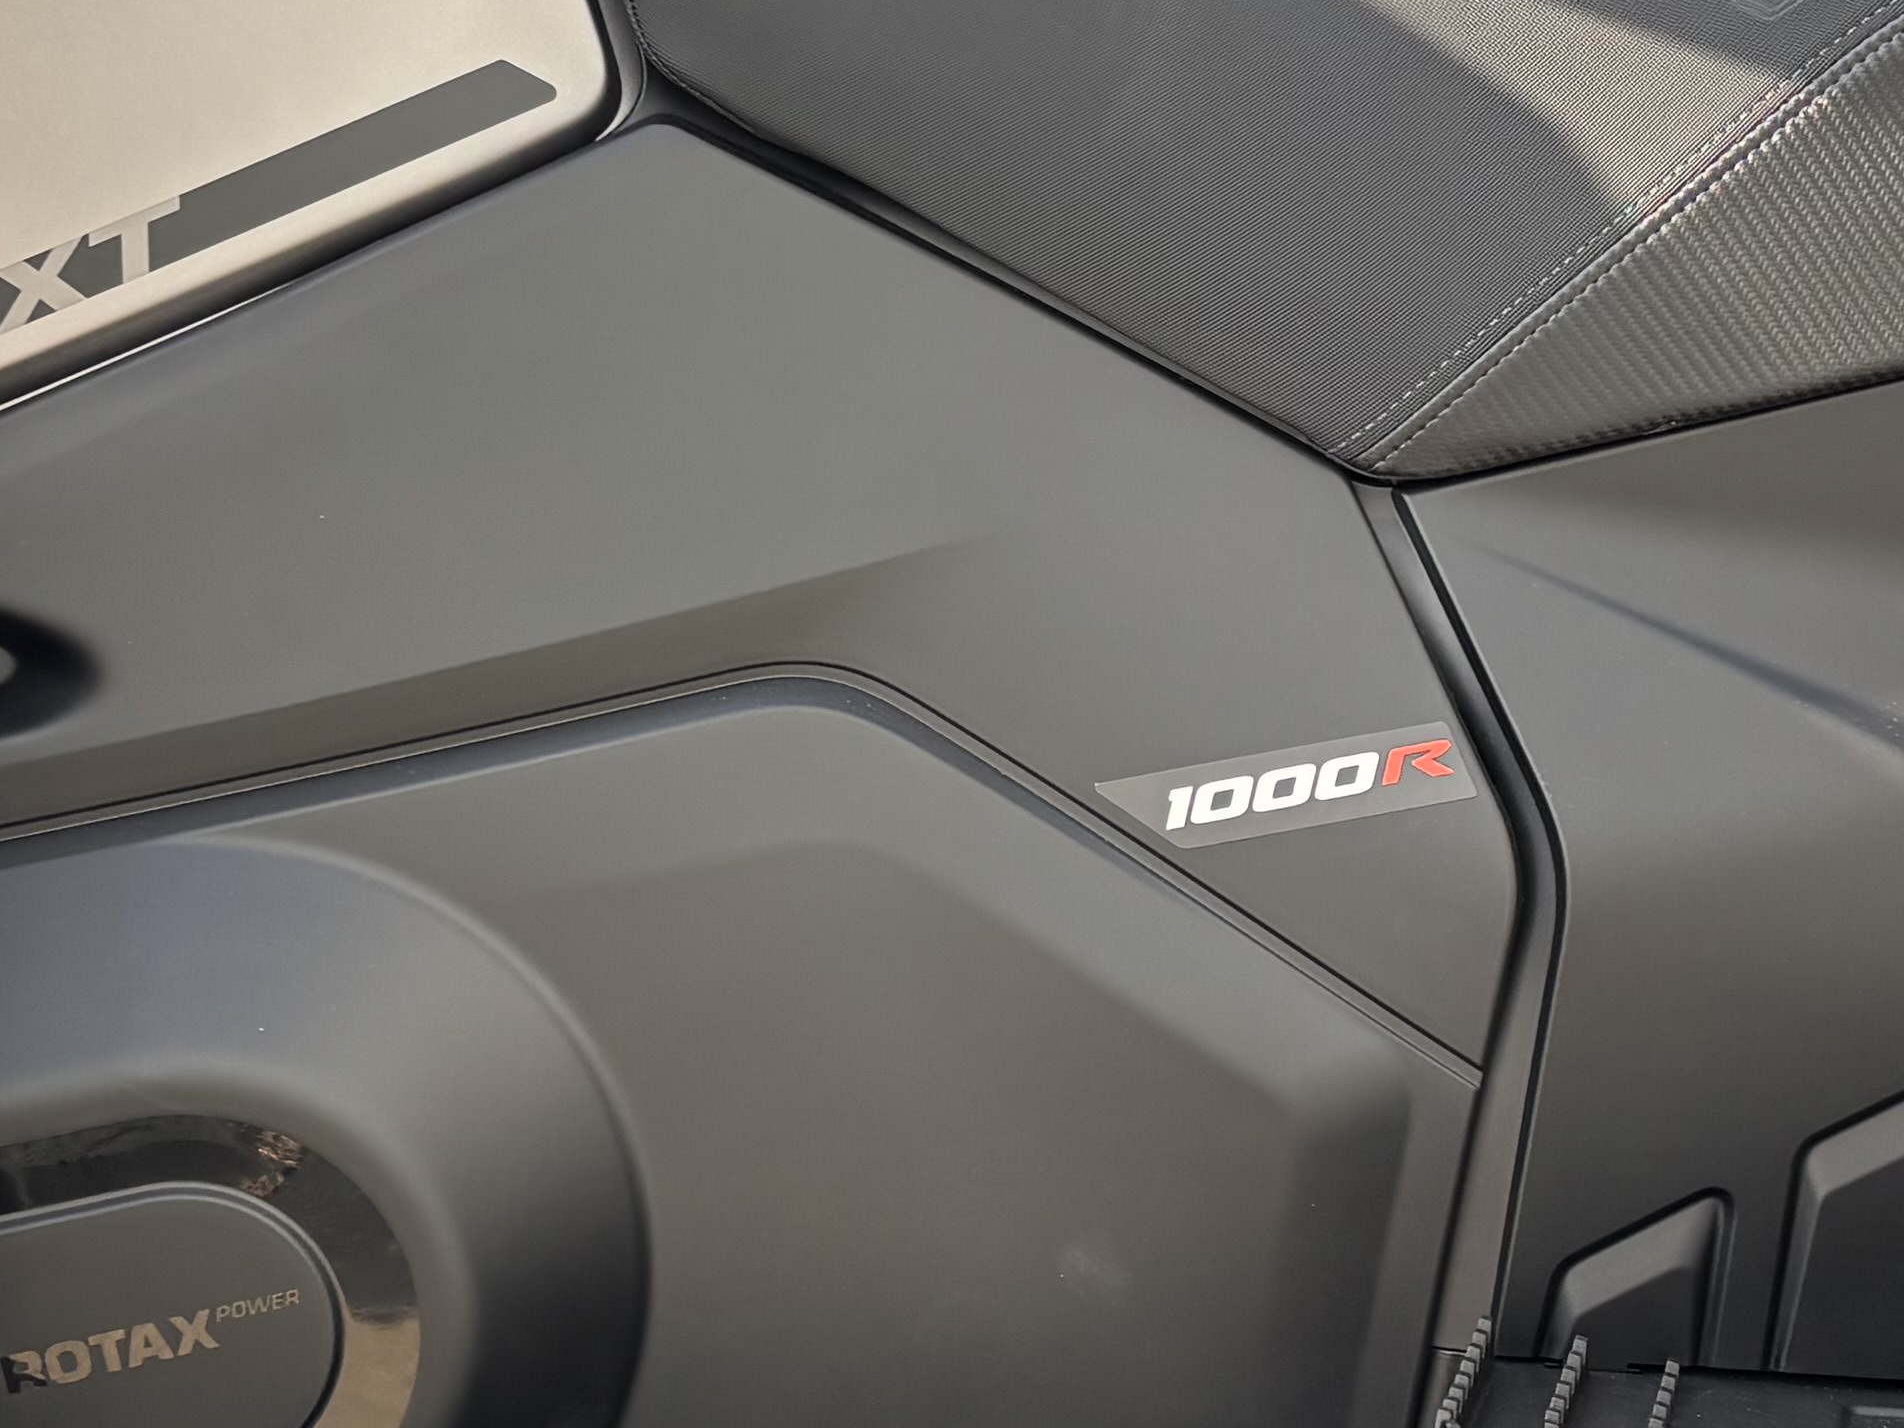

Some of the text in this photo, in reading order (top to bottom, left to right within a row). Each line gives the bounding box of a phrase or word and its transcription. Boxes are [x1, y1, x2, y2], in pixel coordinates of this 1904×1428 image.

[1166, 738, 1454, 830] 1000R
[1, 1288, 300, 1394] ROTAX POWER
